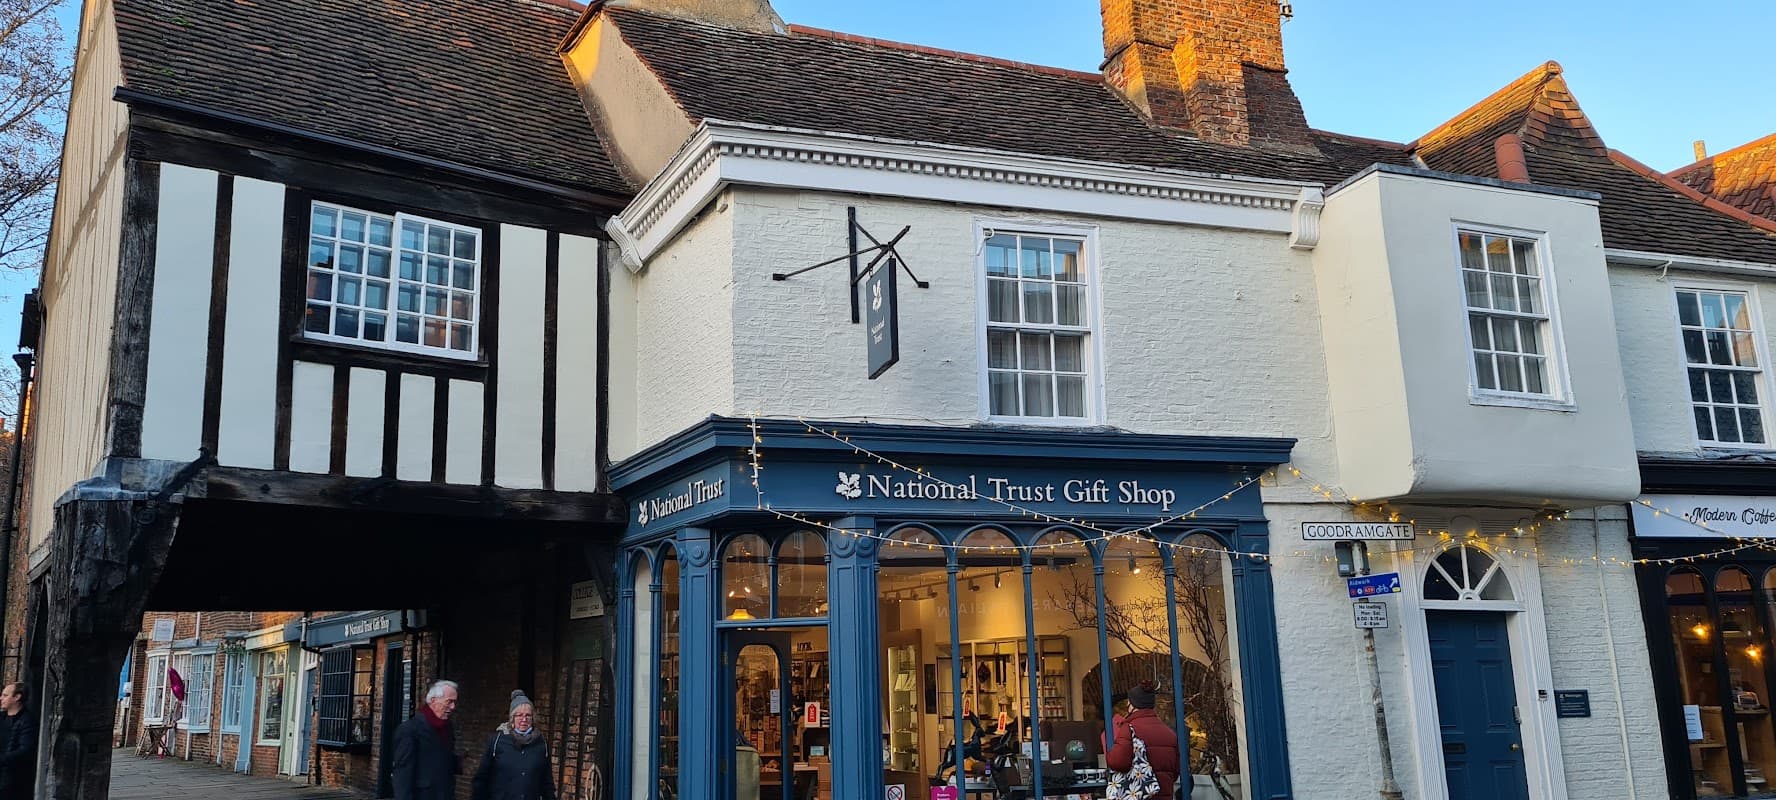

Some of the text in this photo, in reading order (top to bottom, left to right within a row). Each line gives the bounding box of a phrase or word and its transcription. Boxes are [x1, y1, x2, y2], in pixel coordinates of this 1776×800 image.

[651, 477, 723, 520] National Trust
[867, 474, 1176, 512] National Trust Gift Shop
[1689, 507, 1738, 525] Modern
[1307, 525, 1410, 538] GOODRAMGATE
